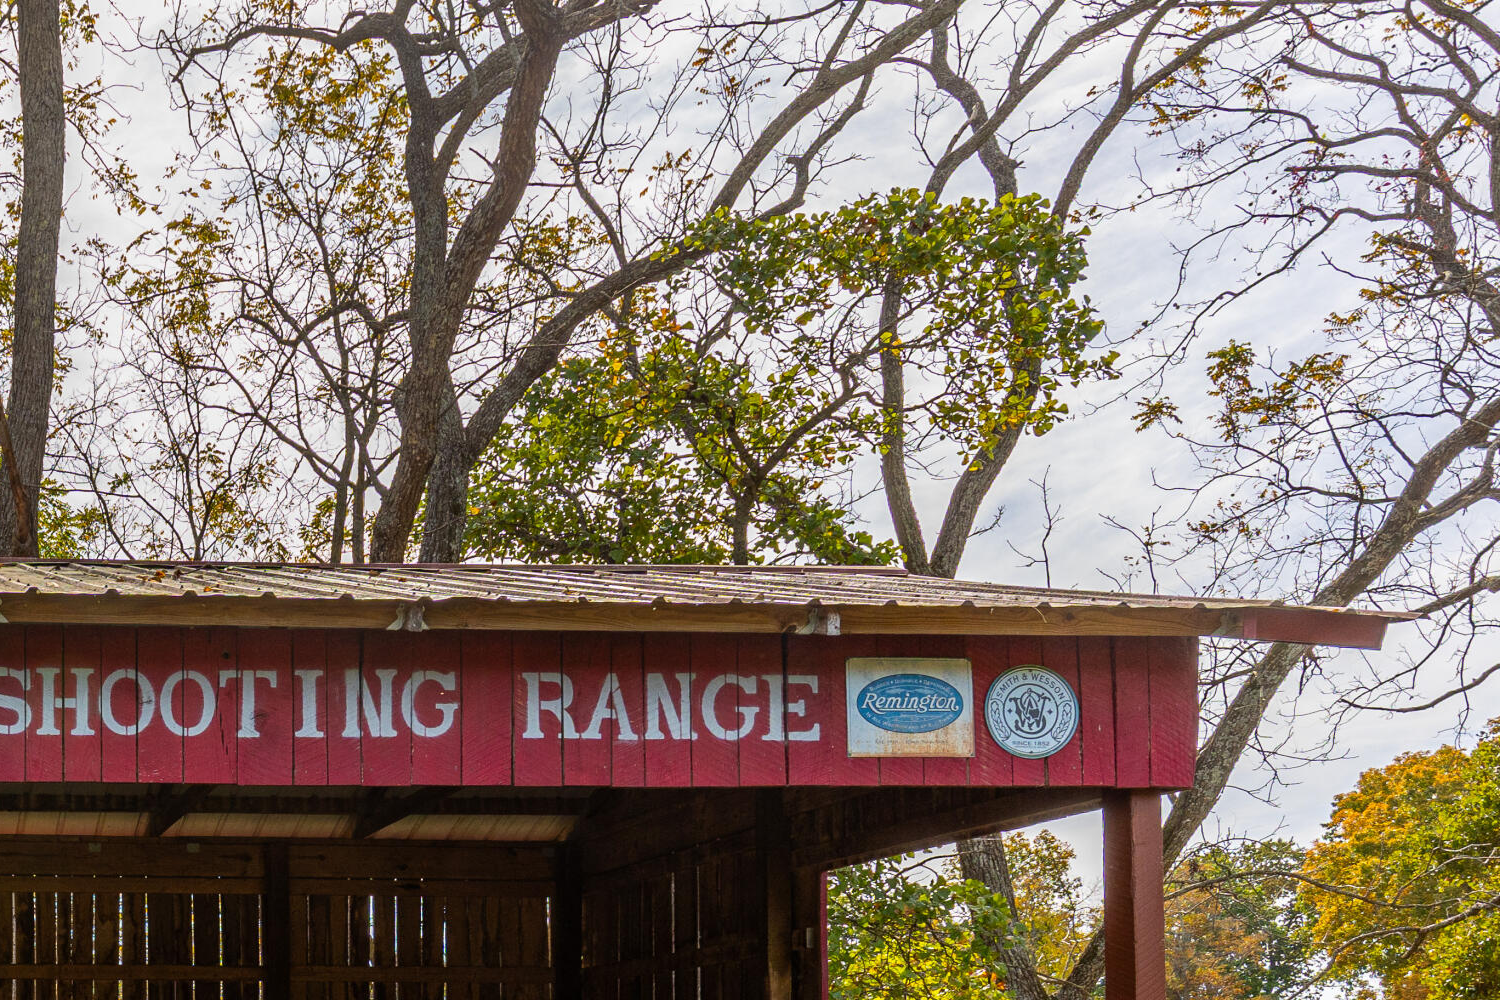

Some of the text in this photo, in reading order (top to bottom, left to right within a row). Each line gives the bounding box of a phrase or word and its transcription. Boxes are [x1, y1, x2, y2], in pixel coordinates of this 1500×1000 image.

[996, 674, 1019, 699] SMITH
[1031, 673, 1066, 700] WESSON
[522, 672, 821, 741] RANGE
[861, 692, 959, 715] Remington
